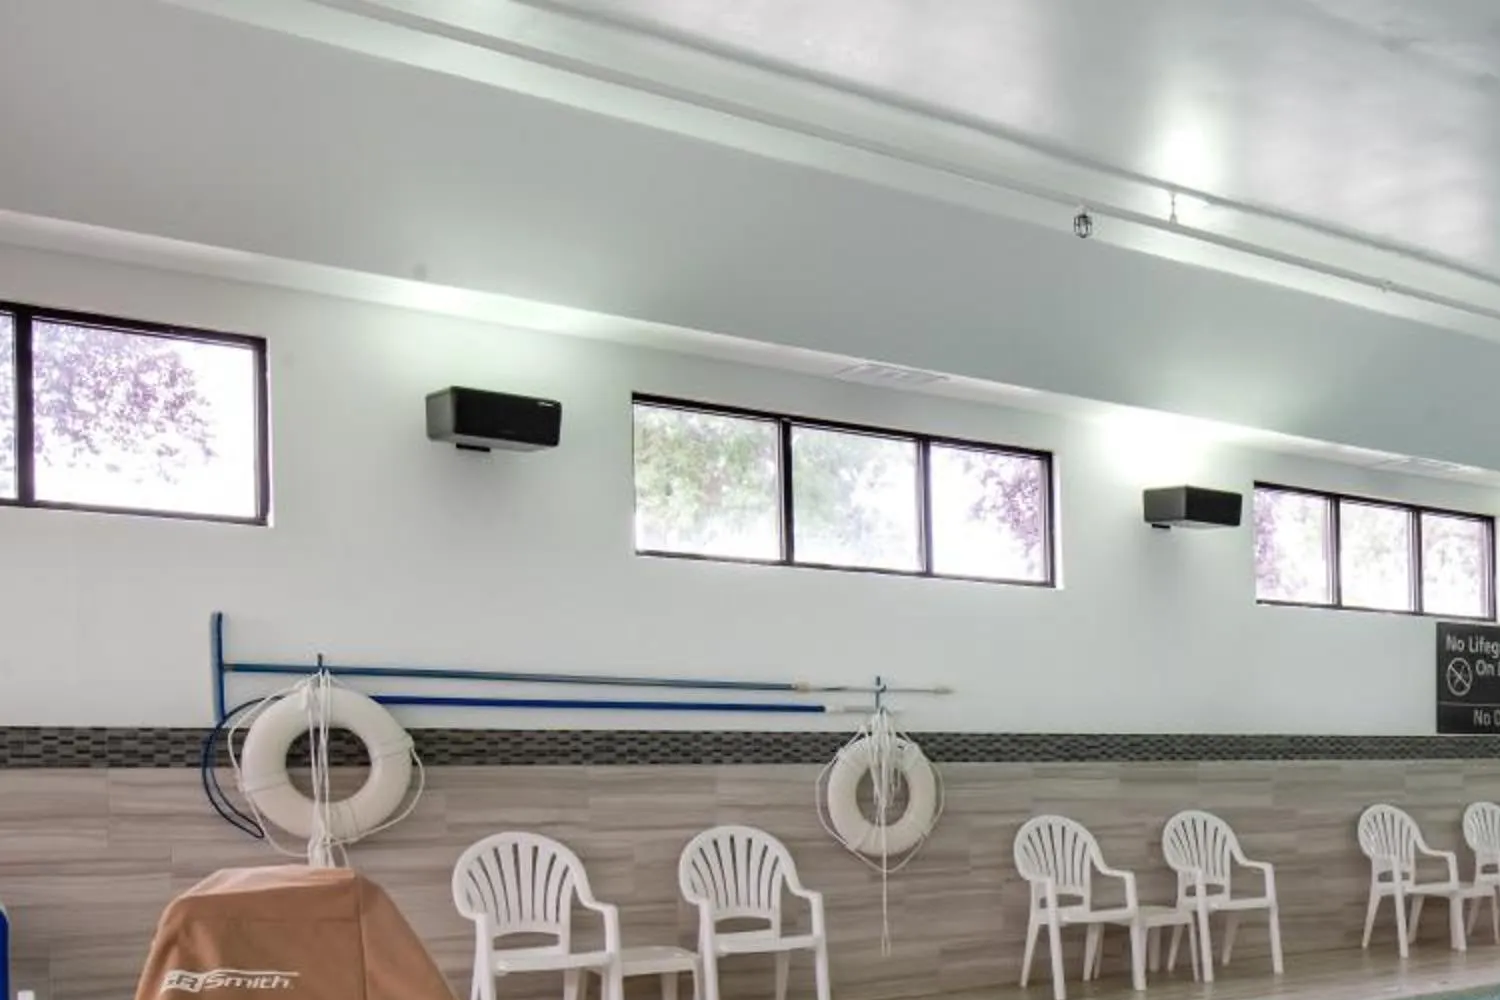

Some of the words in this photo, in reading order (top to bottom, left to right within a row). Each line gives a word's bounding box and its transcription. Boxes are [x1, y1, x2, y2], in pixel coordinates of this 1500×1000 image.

[1446, 634, 1465, 652] No
[1475, 659, 1495, 676] On
[1473, 708, 1491, 727] No
